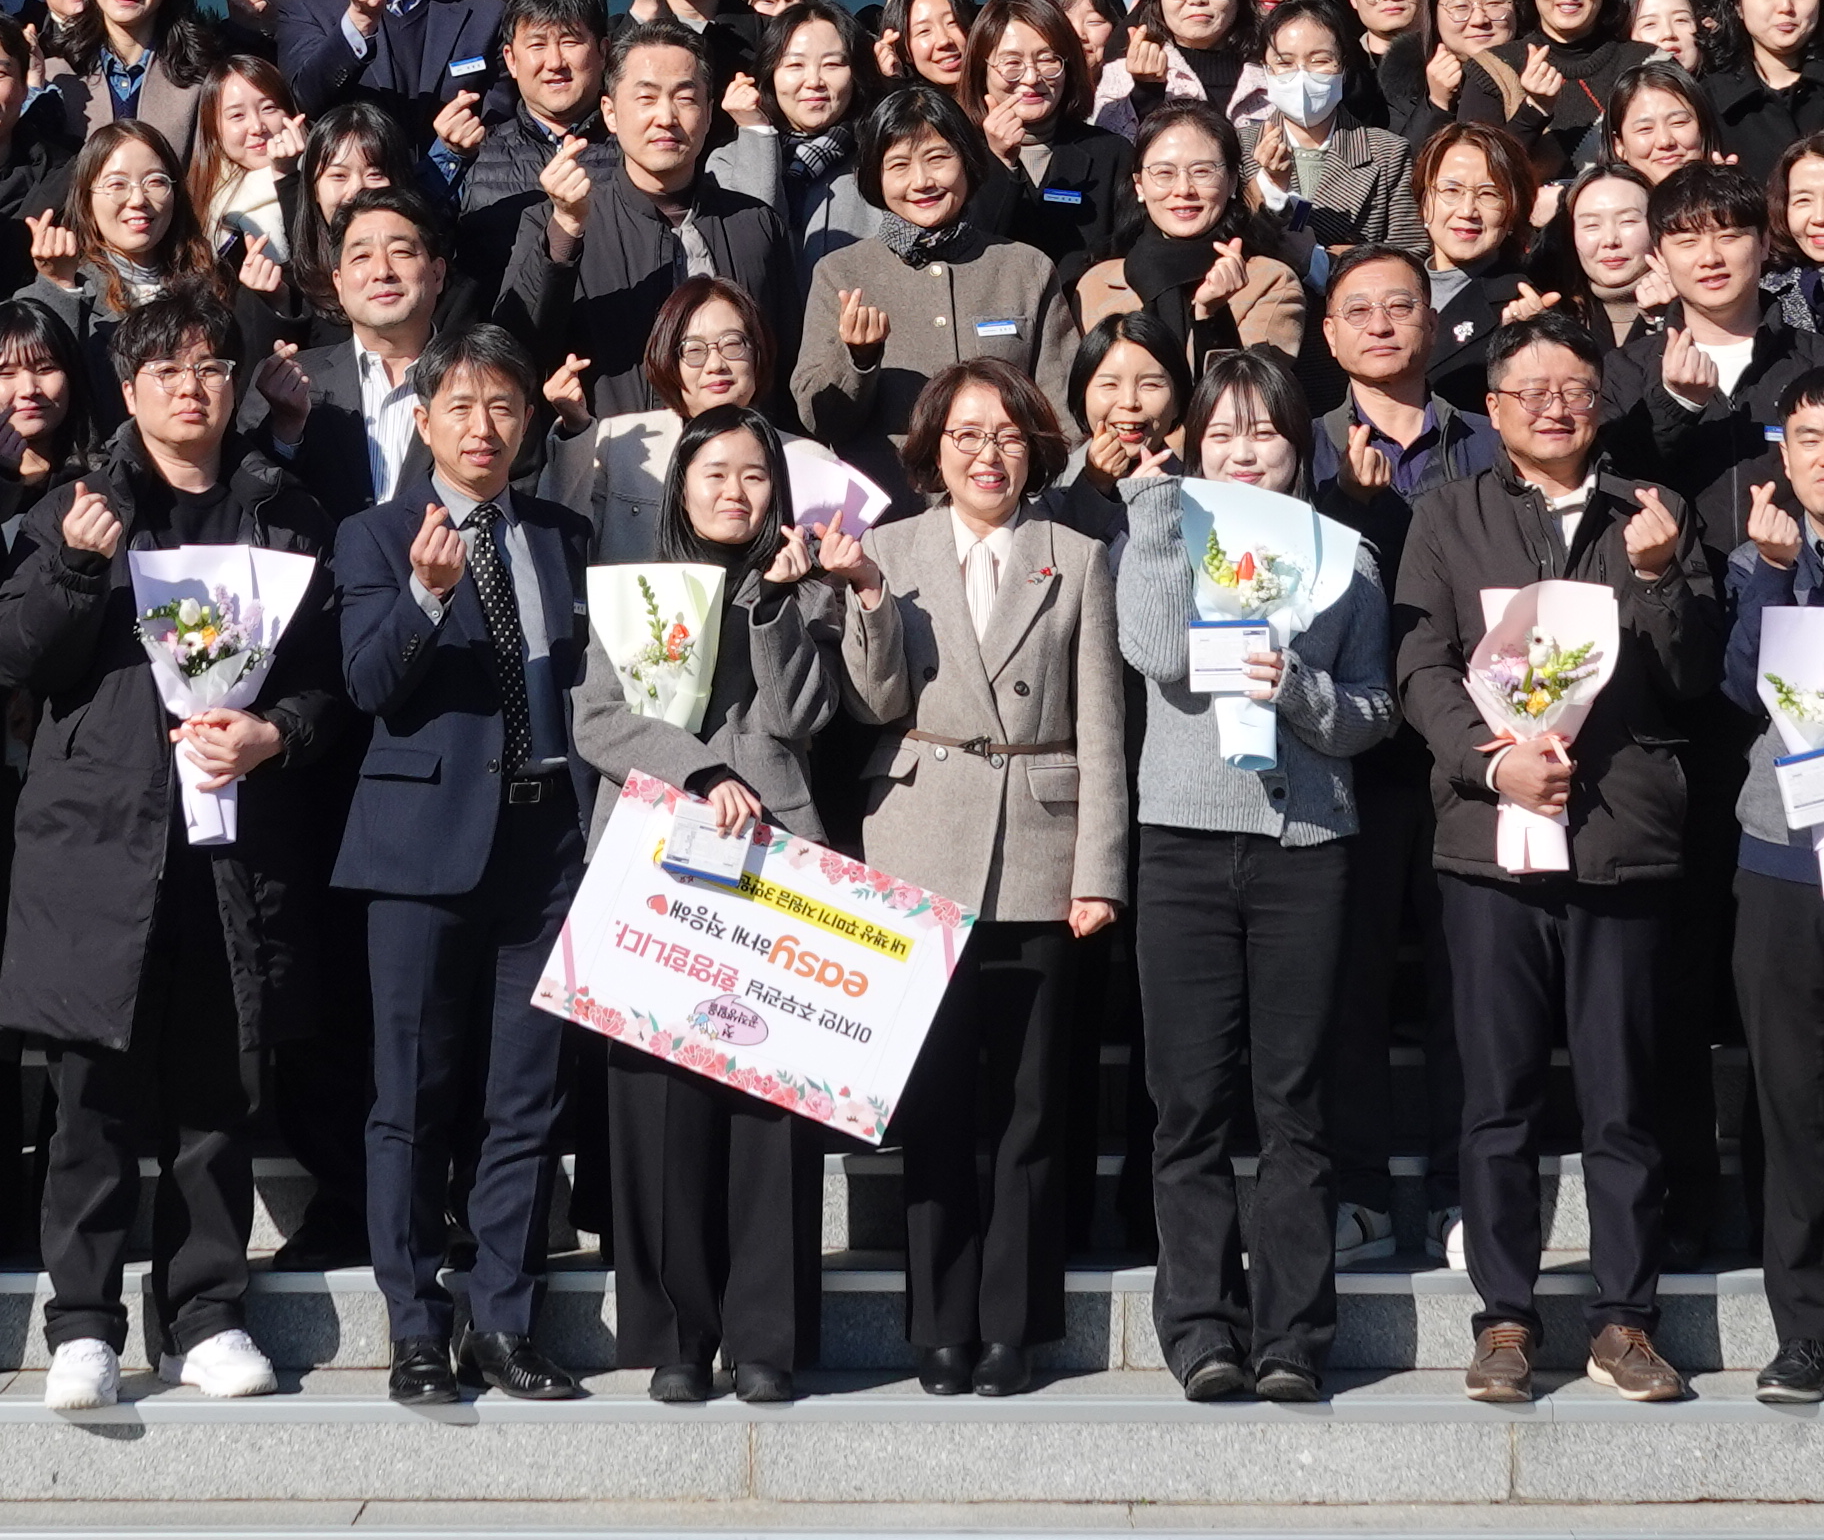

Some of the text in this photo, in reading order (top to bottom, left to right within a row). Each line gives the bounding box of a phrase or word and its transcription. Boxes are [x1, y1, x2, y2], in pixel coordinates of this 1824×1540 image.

[775, 890, 818, 919] 지원금
[669, 899, 727, 940] 적응해
[817, 907, 860, 936] 꾸미기
[860, 924, 890, 950] 책상
[889, 938, 906, 955] 내
[615, 920, 873, 1044] 이지안 주무관님 환영합니다.
[721, 1022, 734, 1039] 첫
